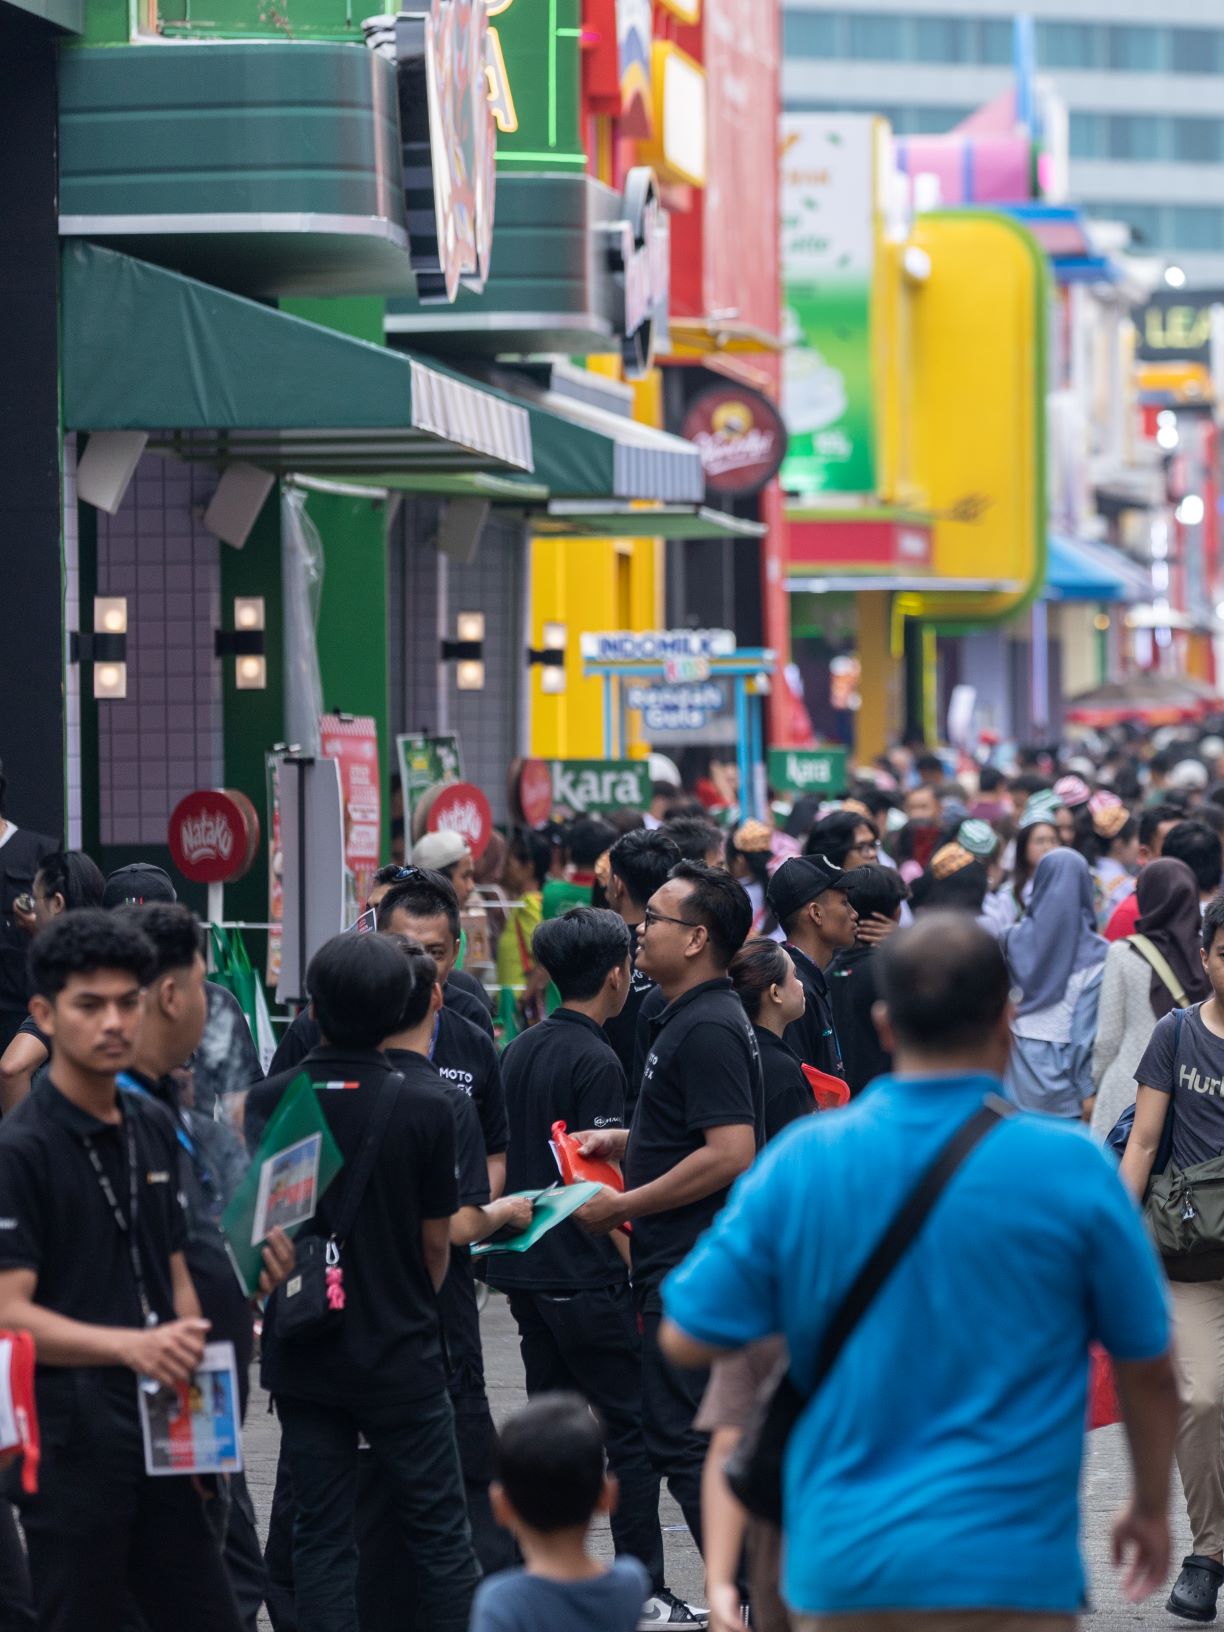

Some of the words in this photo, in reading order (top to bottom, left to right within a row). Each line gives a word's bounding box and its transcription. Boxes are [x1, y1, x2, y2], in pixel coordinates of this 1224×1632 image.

[597, 632, 714, 657] INDOMILK
[551, 760, 643, 813] kara
[439, 1067, 473, 1083] MOTO
